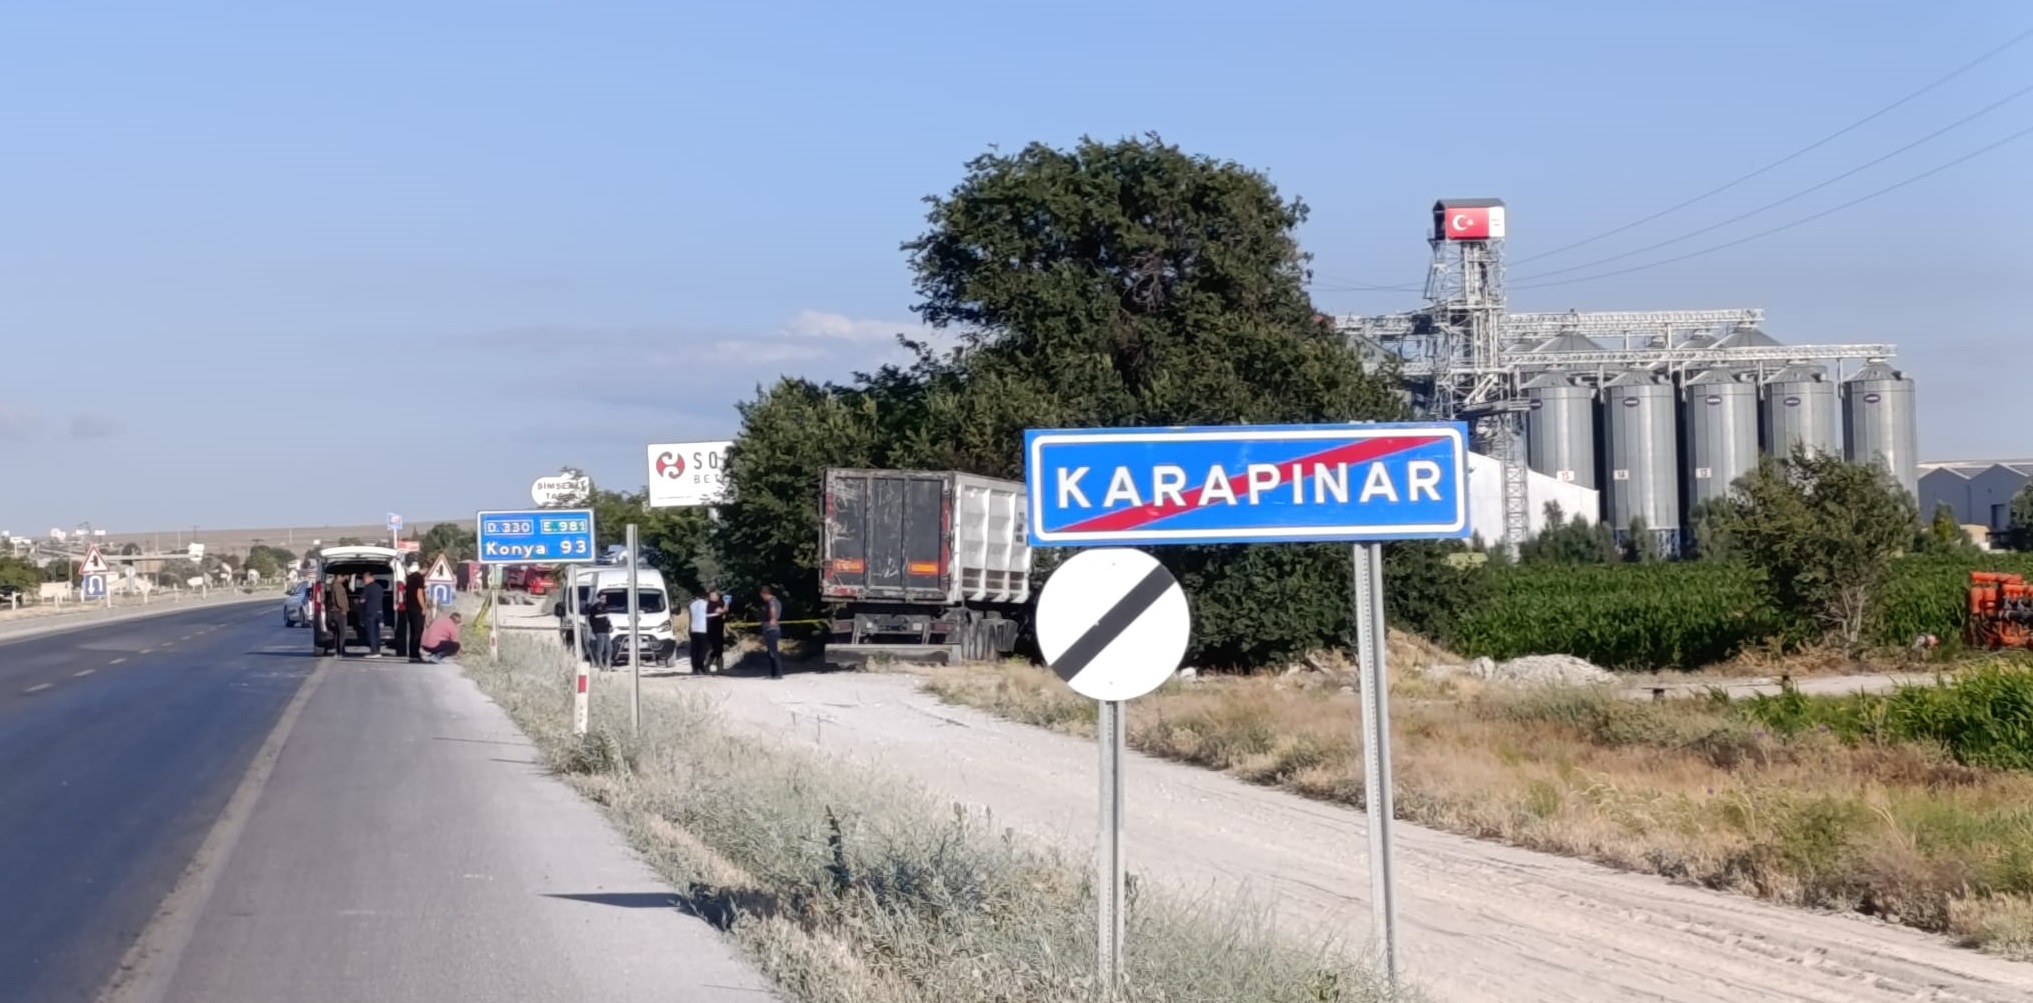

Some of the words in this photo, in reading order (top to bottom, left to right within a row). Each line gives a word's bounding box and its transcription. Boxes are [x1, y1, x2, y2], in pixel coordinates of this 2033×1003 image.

[1057, 459, 1443, 509] KARAPINAR
[487, 521, 531, 533] D.330
[543, 520, 587, 533] E.981
[486, 540, 547, 559] Konya
[560, 539, 587, 555] 93
